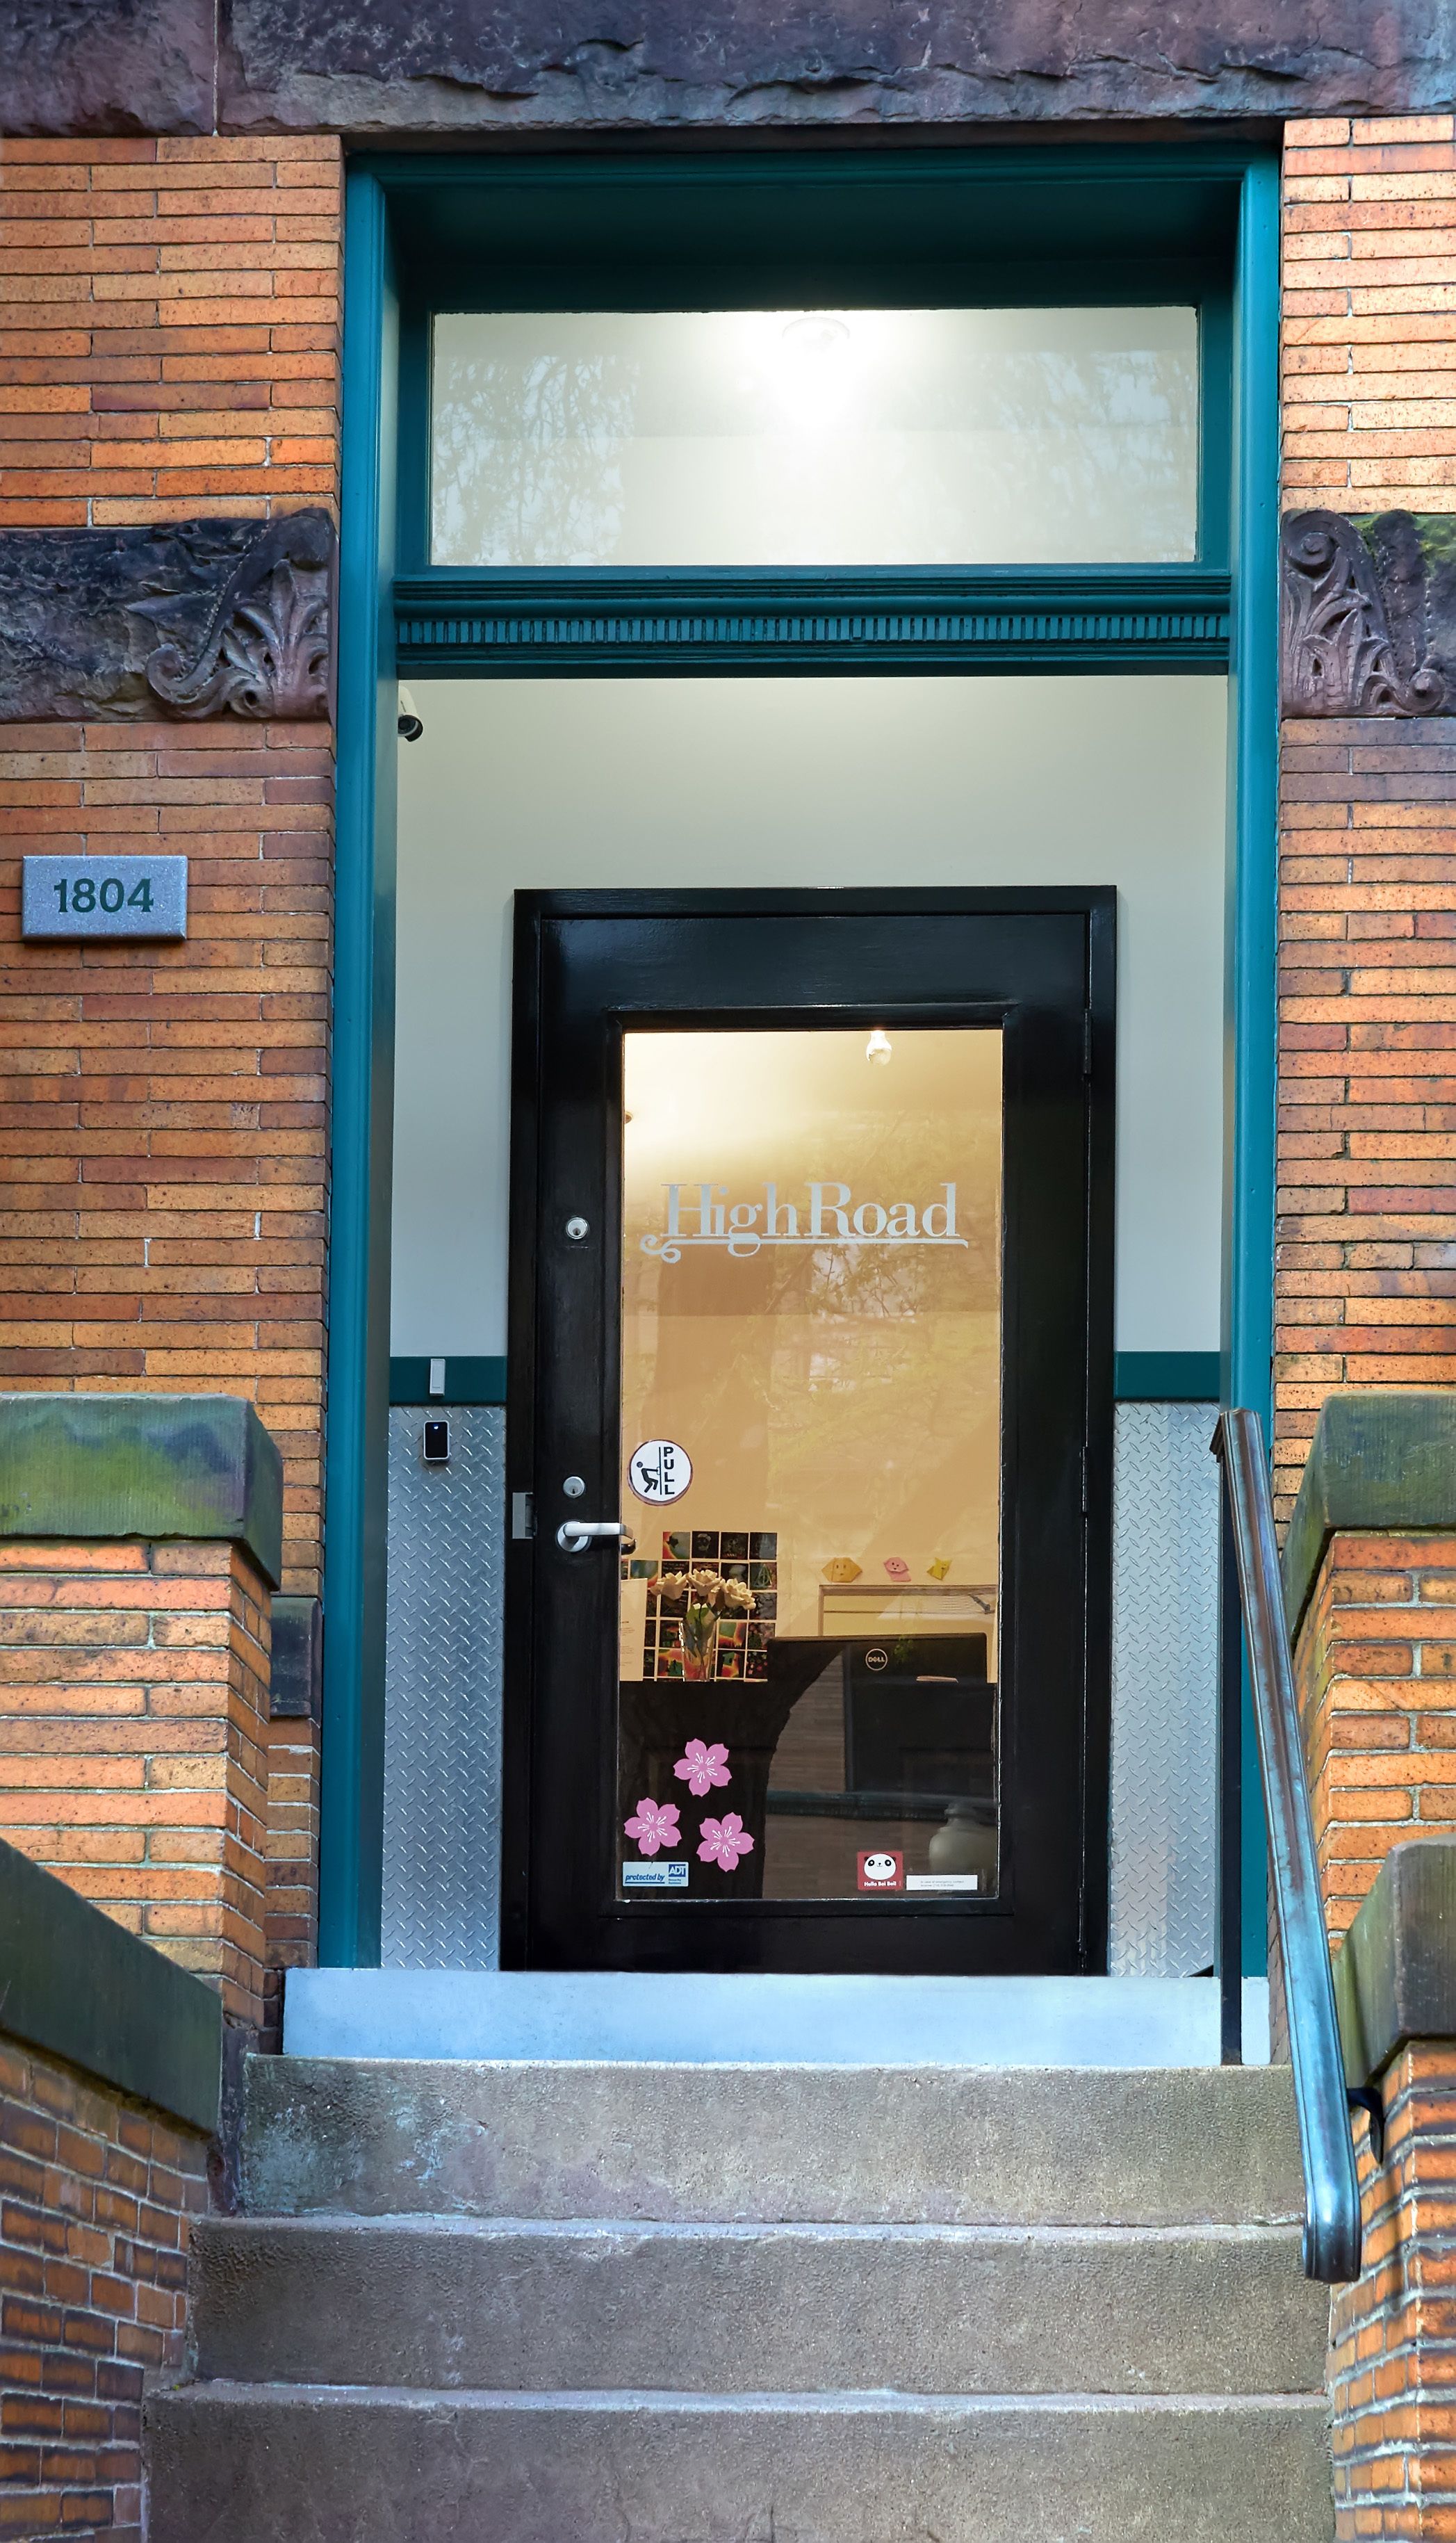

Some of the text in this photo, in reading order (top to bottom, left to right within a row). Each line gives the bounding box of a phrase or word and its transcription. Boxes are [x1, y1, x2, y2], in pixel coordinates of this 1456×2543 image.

[54, 878, 154, 913] 1804
[664, 1447, 675, 1495] PULL
[669, 1865, 685, 1875] ADT
